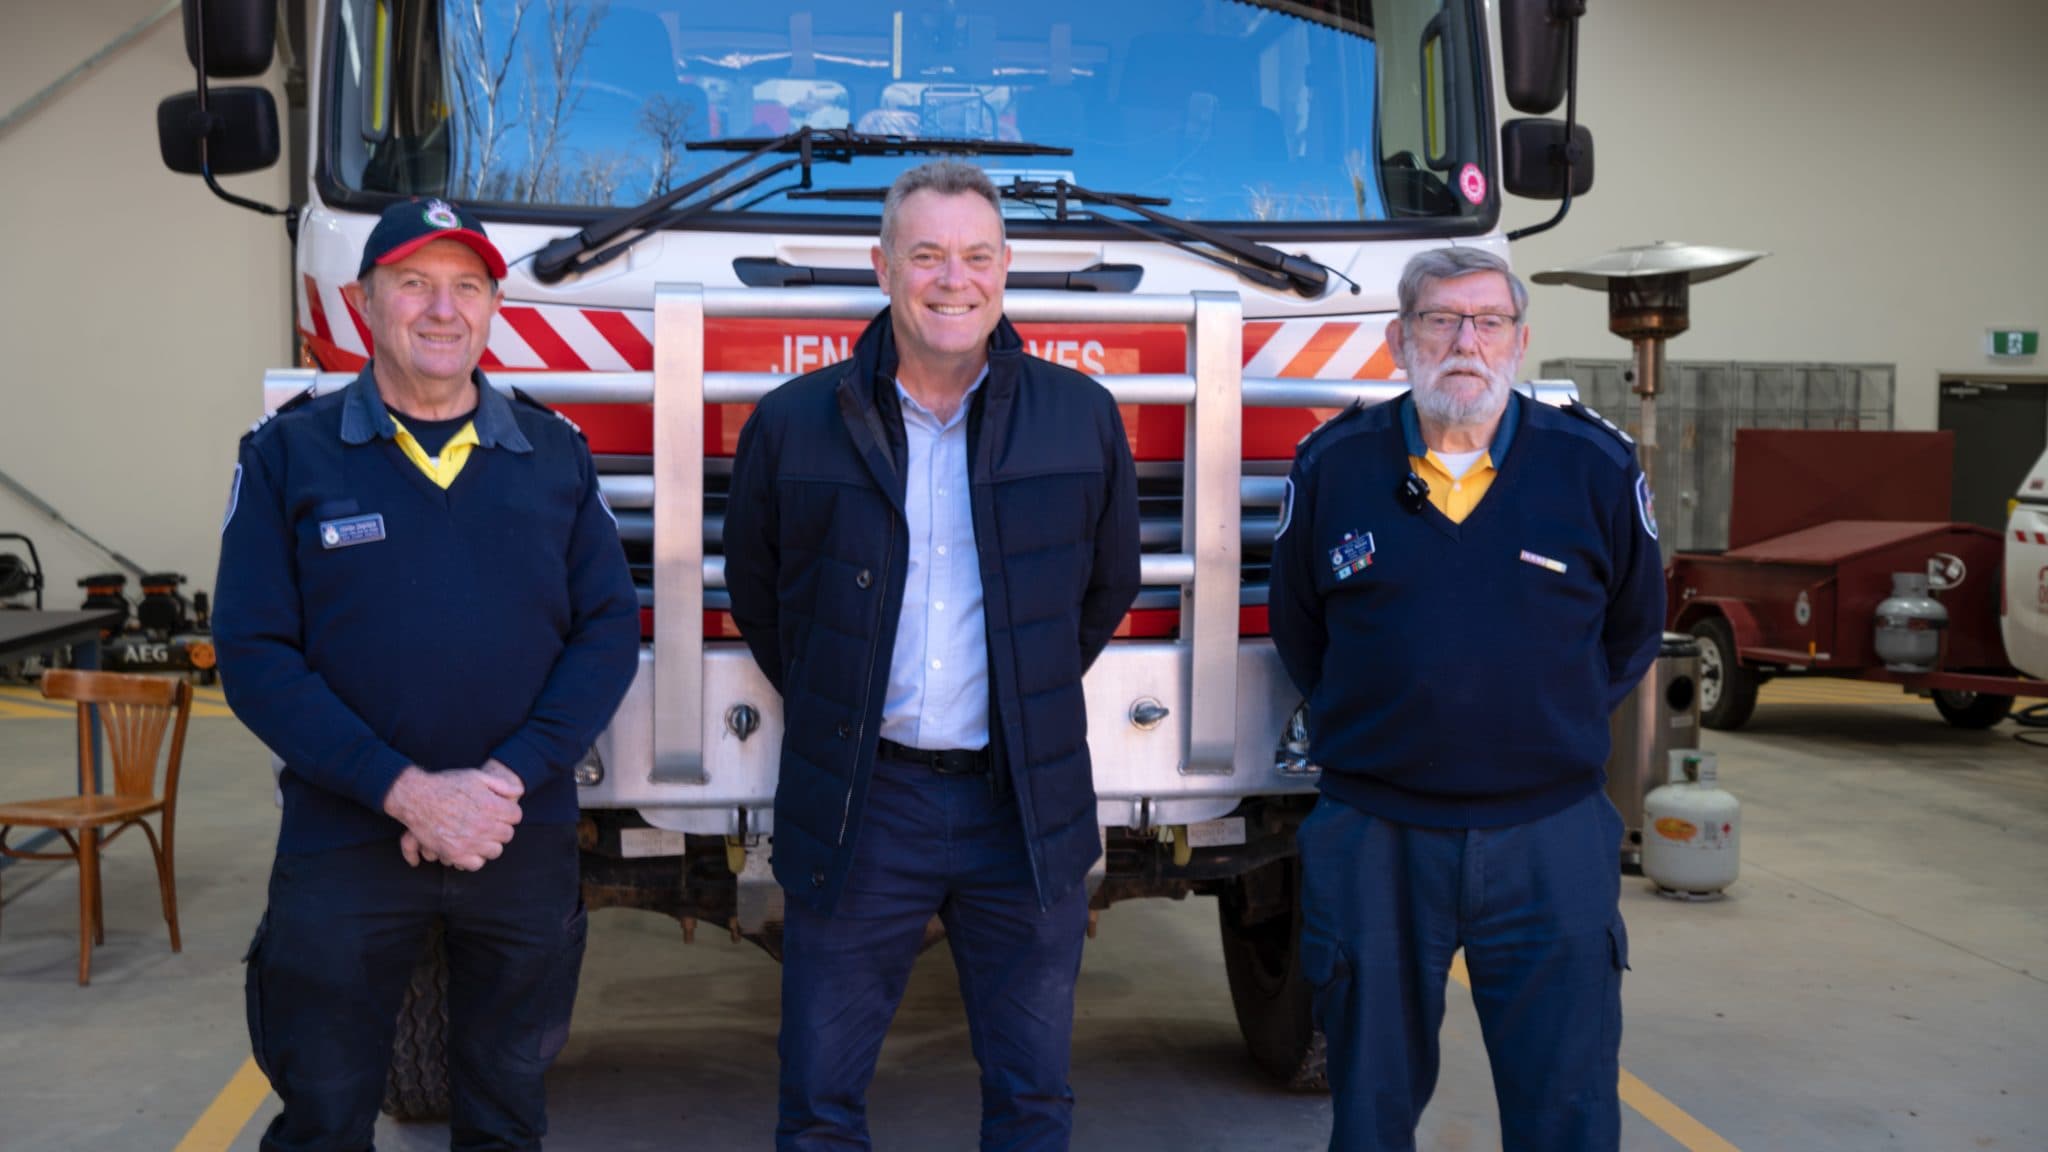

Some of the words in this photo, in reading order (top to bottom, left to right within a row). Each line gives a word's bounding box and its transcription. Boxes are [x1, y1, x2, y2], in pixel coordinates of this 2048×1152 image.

[771, 335, 850, 374] JEN
[1028, 340, 1105, 375] VES
[124, 644, 168, 662] AEG
